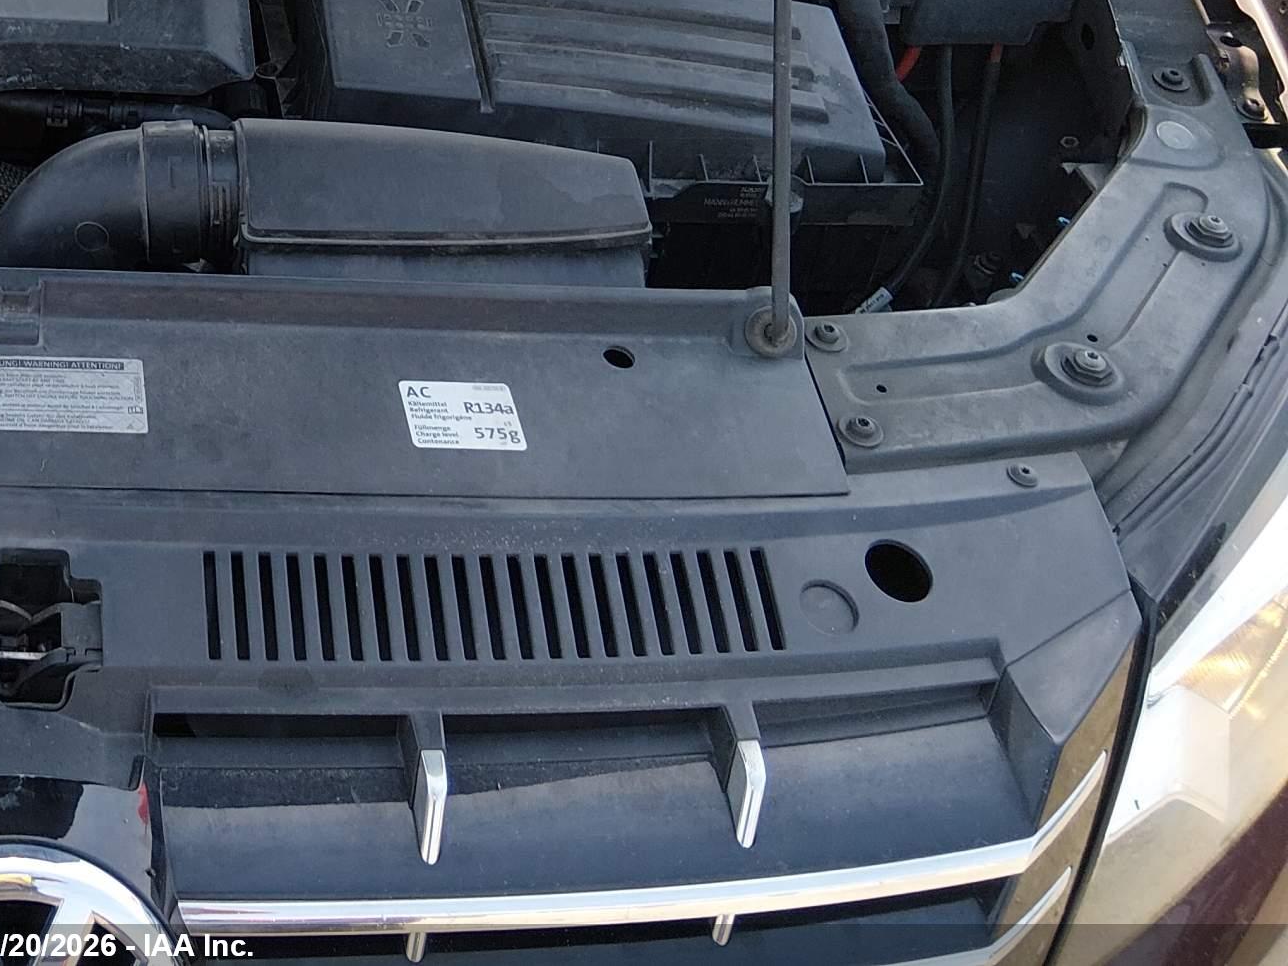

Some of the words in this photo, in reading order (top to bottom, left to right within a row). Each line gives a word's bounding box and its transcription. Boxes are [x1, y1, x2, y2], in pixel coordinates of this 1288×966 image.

[24, 360, 68, 369] WARNING!
[70, 361, 122, 370] ATTENTION!
[406, 386, 431, 398] AC
[463, 402, 514, 415] R134a
[474, 427, 521, 444] 575g
